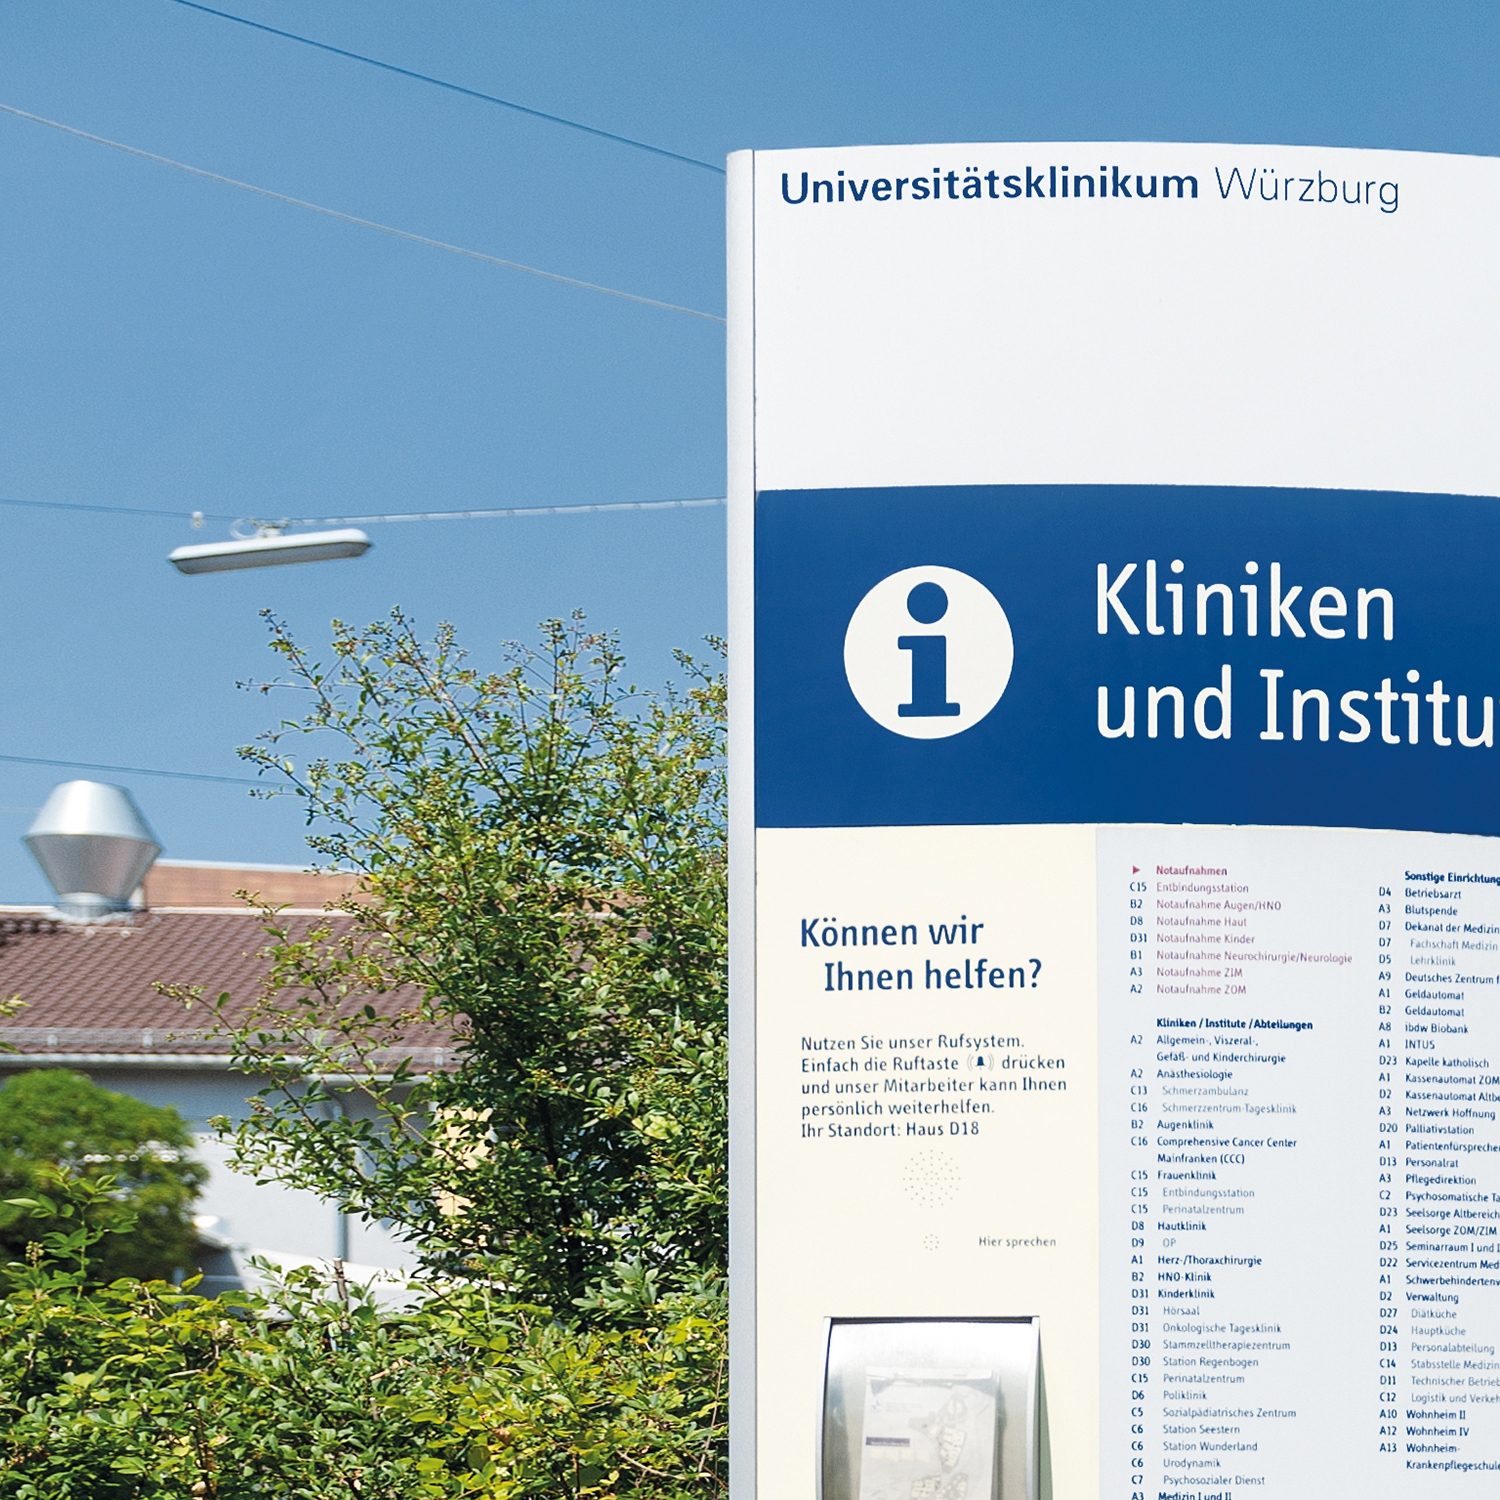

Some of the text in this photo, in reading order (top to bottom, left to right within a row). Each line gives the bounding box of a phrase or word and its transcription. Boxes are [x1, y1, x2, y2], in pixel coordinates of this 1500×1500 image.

[782, 166, 1398, 213] Universitätsklinikum Würzburg
[1097, 559, 1393, 640] Kliniken
[1098, 664, 1231, 739] und
[1155, 865, 1227, 875] Notaufnahmen
[1404, 871, 1445, 884] Sonstige
[1129, 882, 1248, 895] C15 Entbindungsstation
[1378, 887, 1461, 899] D4 Betriebsarzt
[1129, 899, 1281, 912] B2 Notaufnahme Augen/HNO
[1129, 916, 1246, 926] D8 Notaufnahme Haut
[802, 915, 984, 947] Können wir
[1129, 950, 1352, 965] B1 Notaufnahme Neurochirurgie/Neurologie
[825, 958, 1041, 991] Ihnen helfen?
[1378, 988, 1464, 1000] A1 Geldautomat
[801, 1033, 1024, 1051] Nutzen Sie unser Rufsystem.
[1378, 1039, 1435, 1049] A1 INTUS
[802, 1055, 1065, 1073] Einfach die Ruftaste drücken
[1130, 1068, 1233, 1081] A2 Anästhesiologie
[801, 1077, 1066, 1094] und unser Mitarbeiter kann Ihnen
[802, 1099, 994, 1120] persönlich weiterhelfen.
[802, 1121, 979, 1138] Ihr Standort: Haus D18
[1130, 1120, 1214, 1131] B2 Augenklinik
[1130, 1136, 1297, 1148] C16 Comprehensive Cancer Center
[1157, 1153, 1244, 1164] Mainfranken (CCC)
[1130, 1170, 1216, 1180] C15 Frauenklinik
[1131, 1221, 1206, 1231] D8 Hautklinik
[978, 1236, 1056, 1249] Hier sprechen
[1130, 1255, 1262, 1268] A1 Herz-/Thoraxchirurgie
[1131, 1272, 1211, 1281] B2 HNO-Klinik
[1131, 1289, 1215, 1298] D31 Kinderklinik
[1379, 1291, 1458, 1305] D2 Verwaltung
[1379, 1409, 1465, 1420] A10 Wohnheim II
[1131, 1492, 1144, 1500] A3
[1157, 1492, 1195, 1500] Medizin
[1203, 1492, 1222, 1500] und
